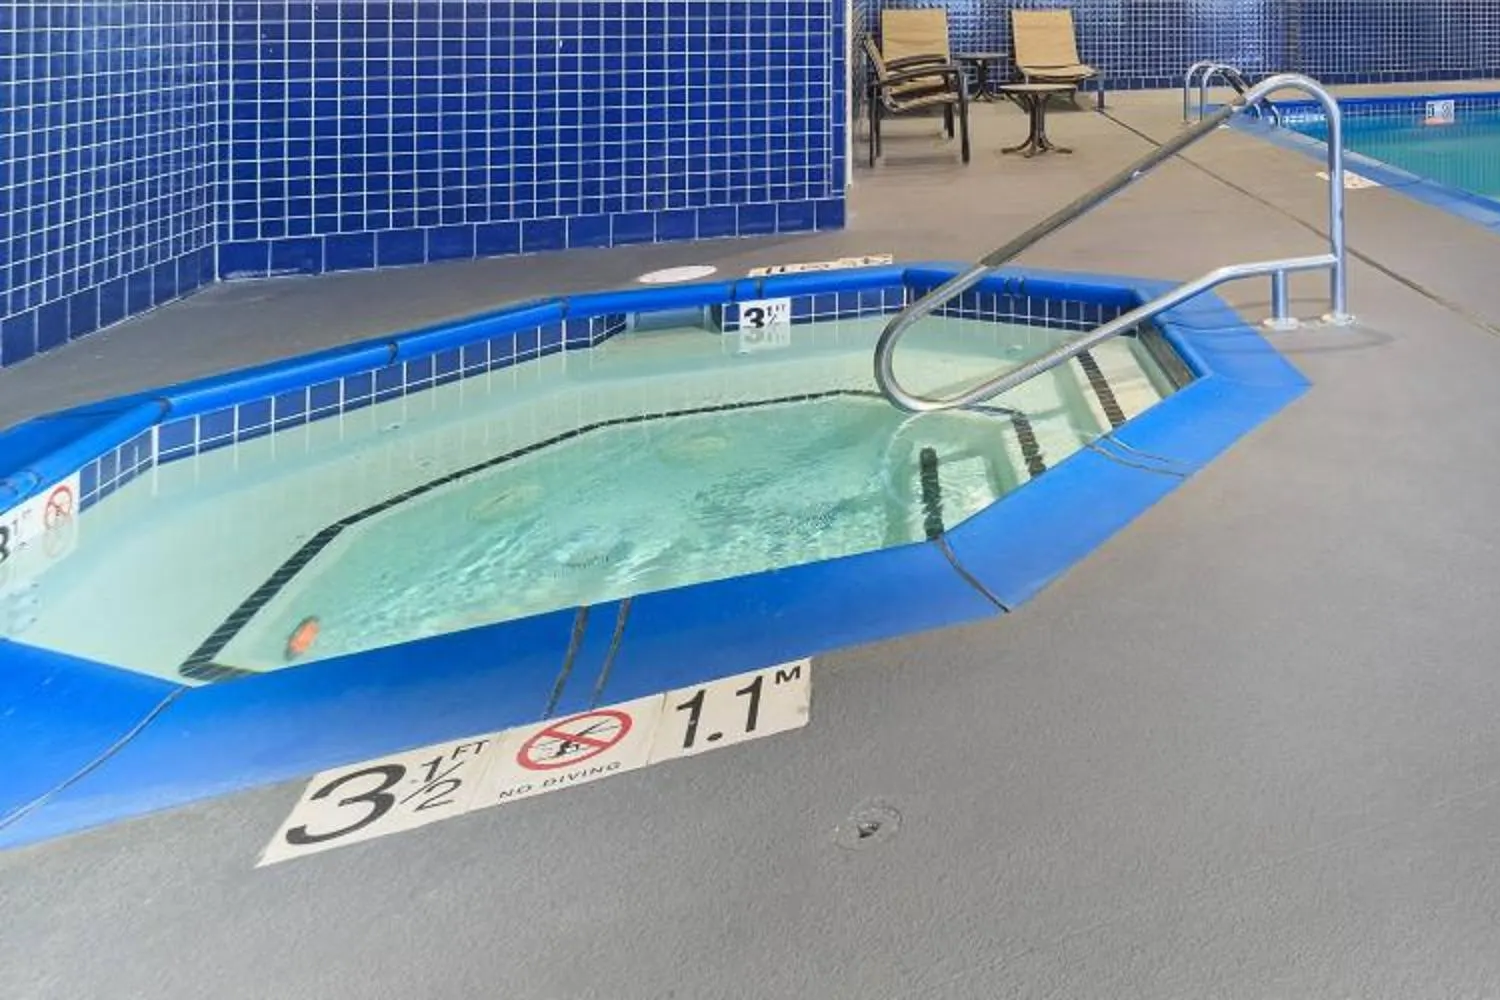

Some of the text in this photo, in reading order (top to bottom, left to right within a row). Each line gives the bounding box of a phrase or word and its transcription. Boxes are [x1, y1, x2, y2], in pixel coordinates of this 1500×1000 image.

[743, 307, 765, 329] 3
[286, 763, 407, 846] 3
[451, 738, 489, 758] FT
[774, 665, 802, 686] M
[498, 761, 622, 799] NO DIVING
